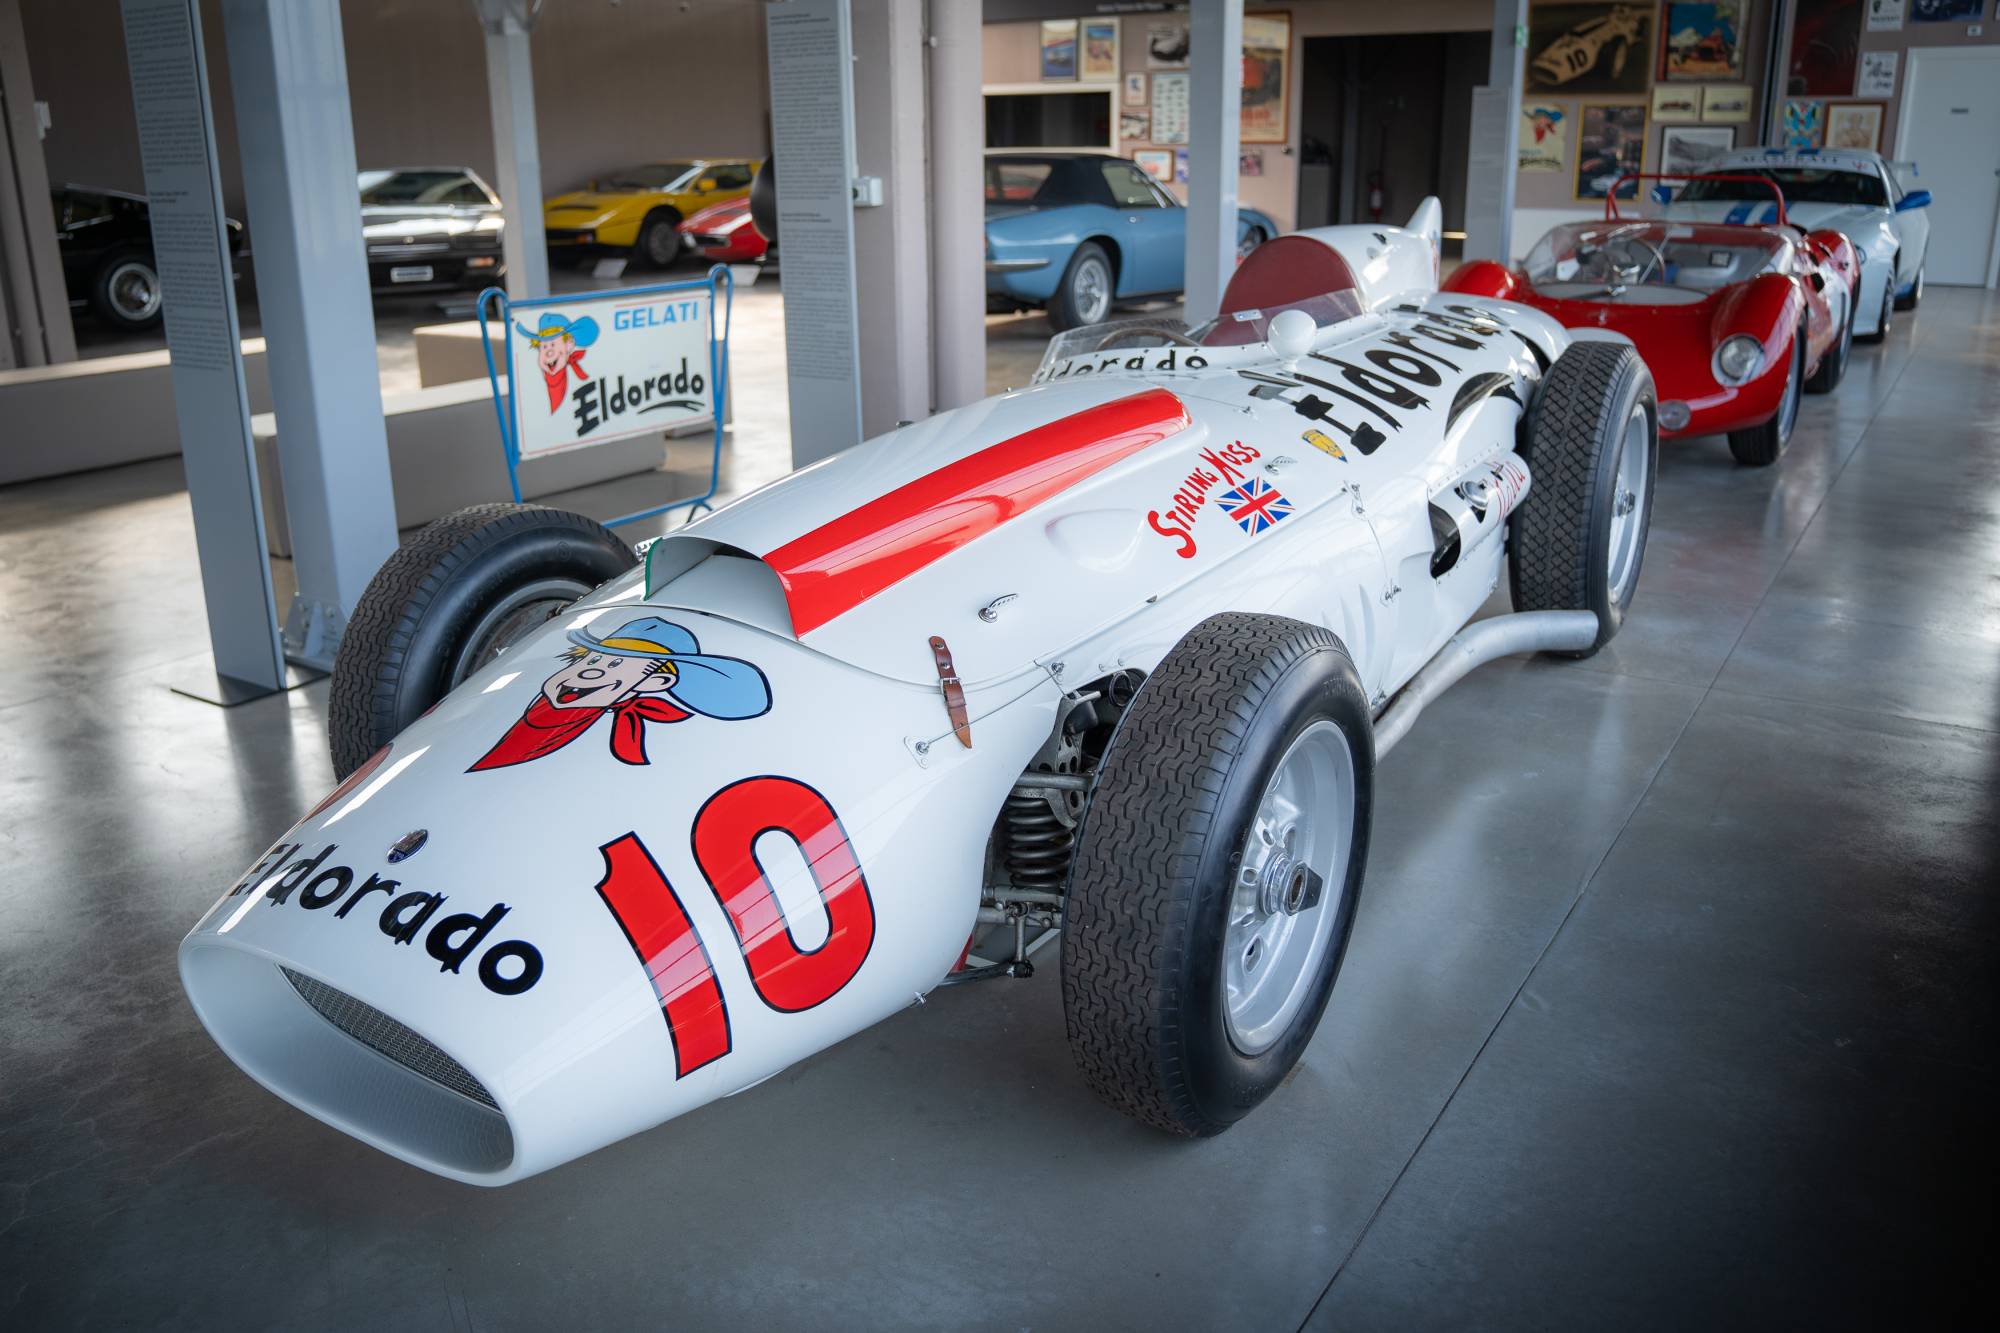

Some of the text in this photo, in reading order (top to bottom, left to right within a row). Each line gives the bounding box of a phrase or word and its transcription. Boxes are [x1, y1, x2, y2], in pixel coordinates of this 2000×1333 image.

[1566, 48, 1588, 73] 10
[613, 301, 699, 332] GELATI
[1034, 349, 1209, 385] ldorado
[572, 357, 705, 437] Eldorado
[594, 774, 876, 1081] 10
